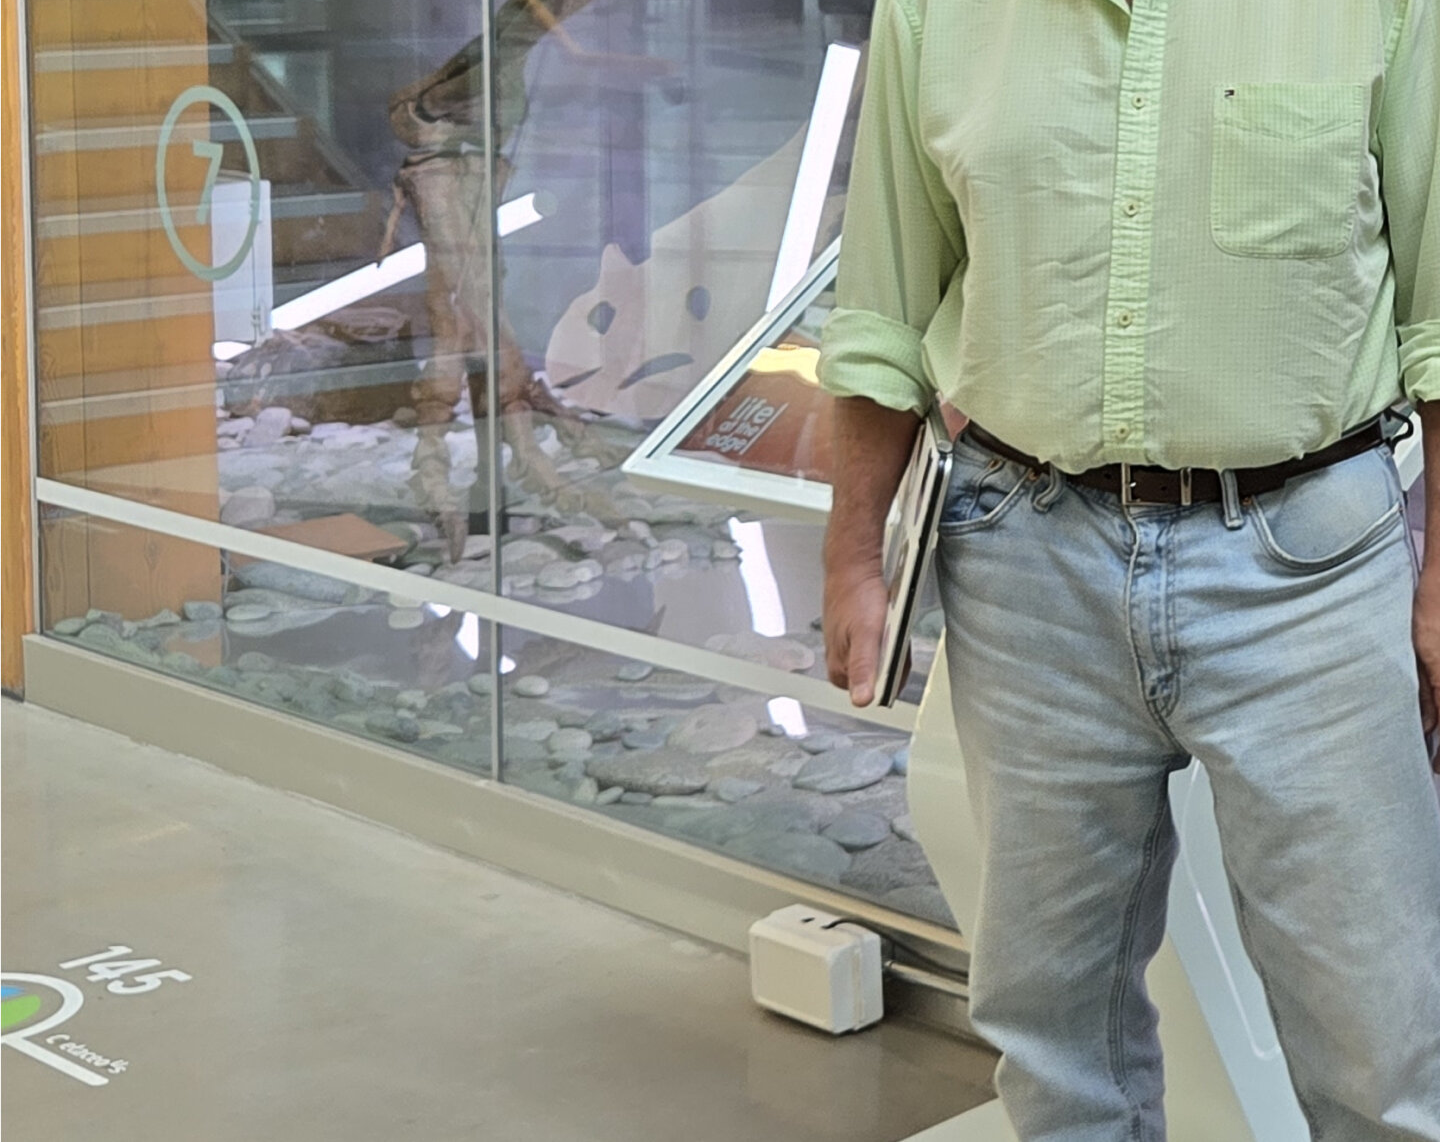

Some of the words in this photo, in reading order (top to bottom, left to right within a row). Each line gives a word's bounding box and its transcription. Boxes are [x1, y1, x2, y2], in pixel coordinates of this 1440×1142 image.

[193, 139, 224, 226] 7
[729, 395, 775, 424] life
[706, 432, 748, 453] edge
[58, 945, 193, 995] 145
